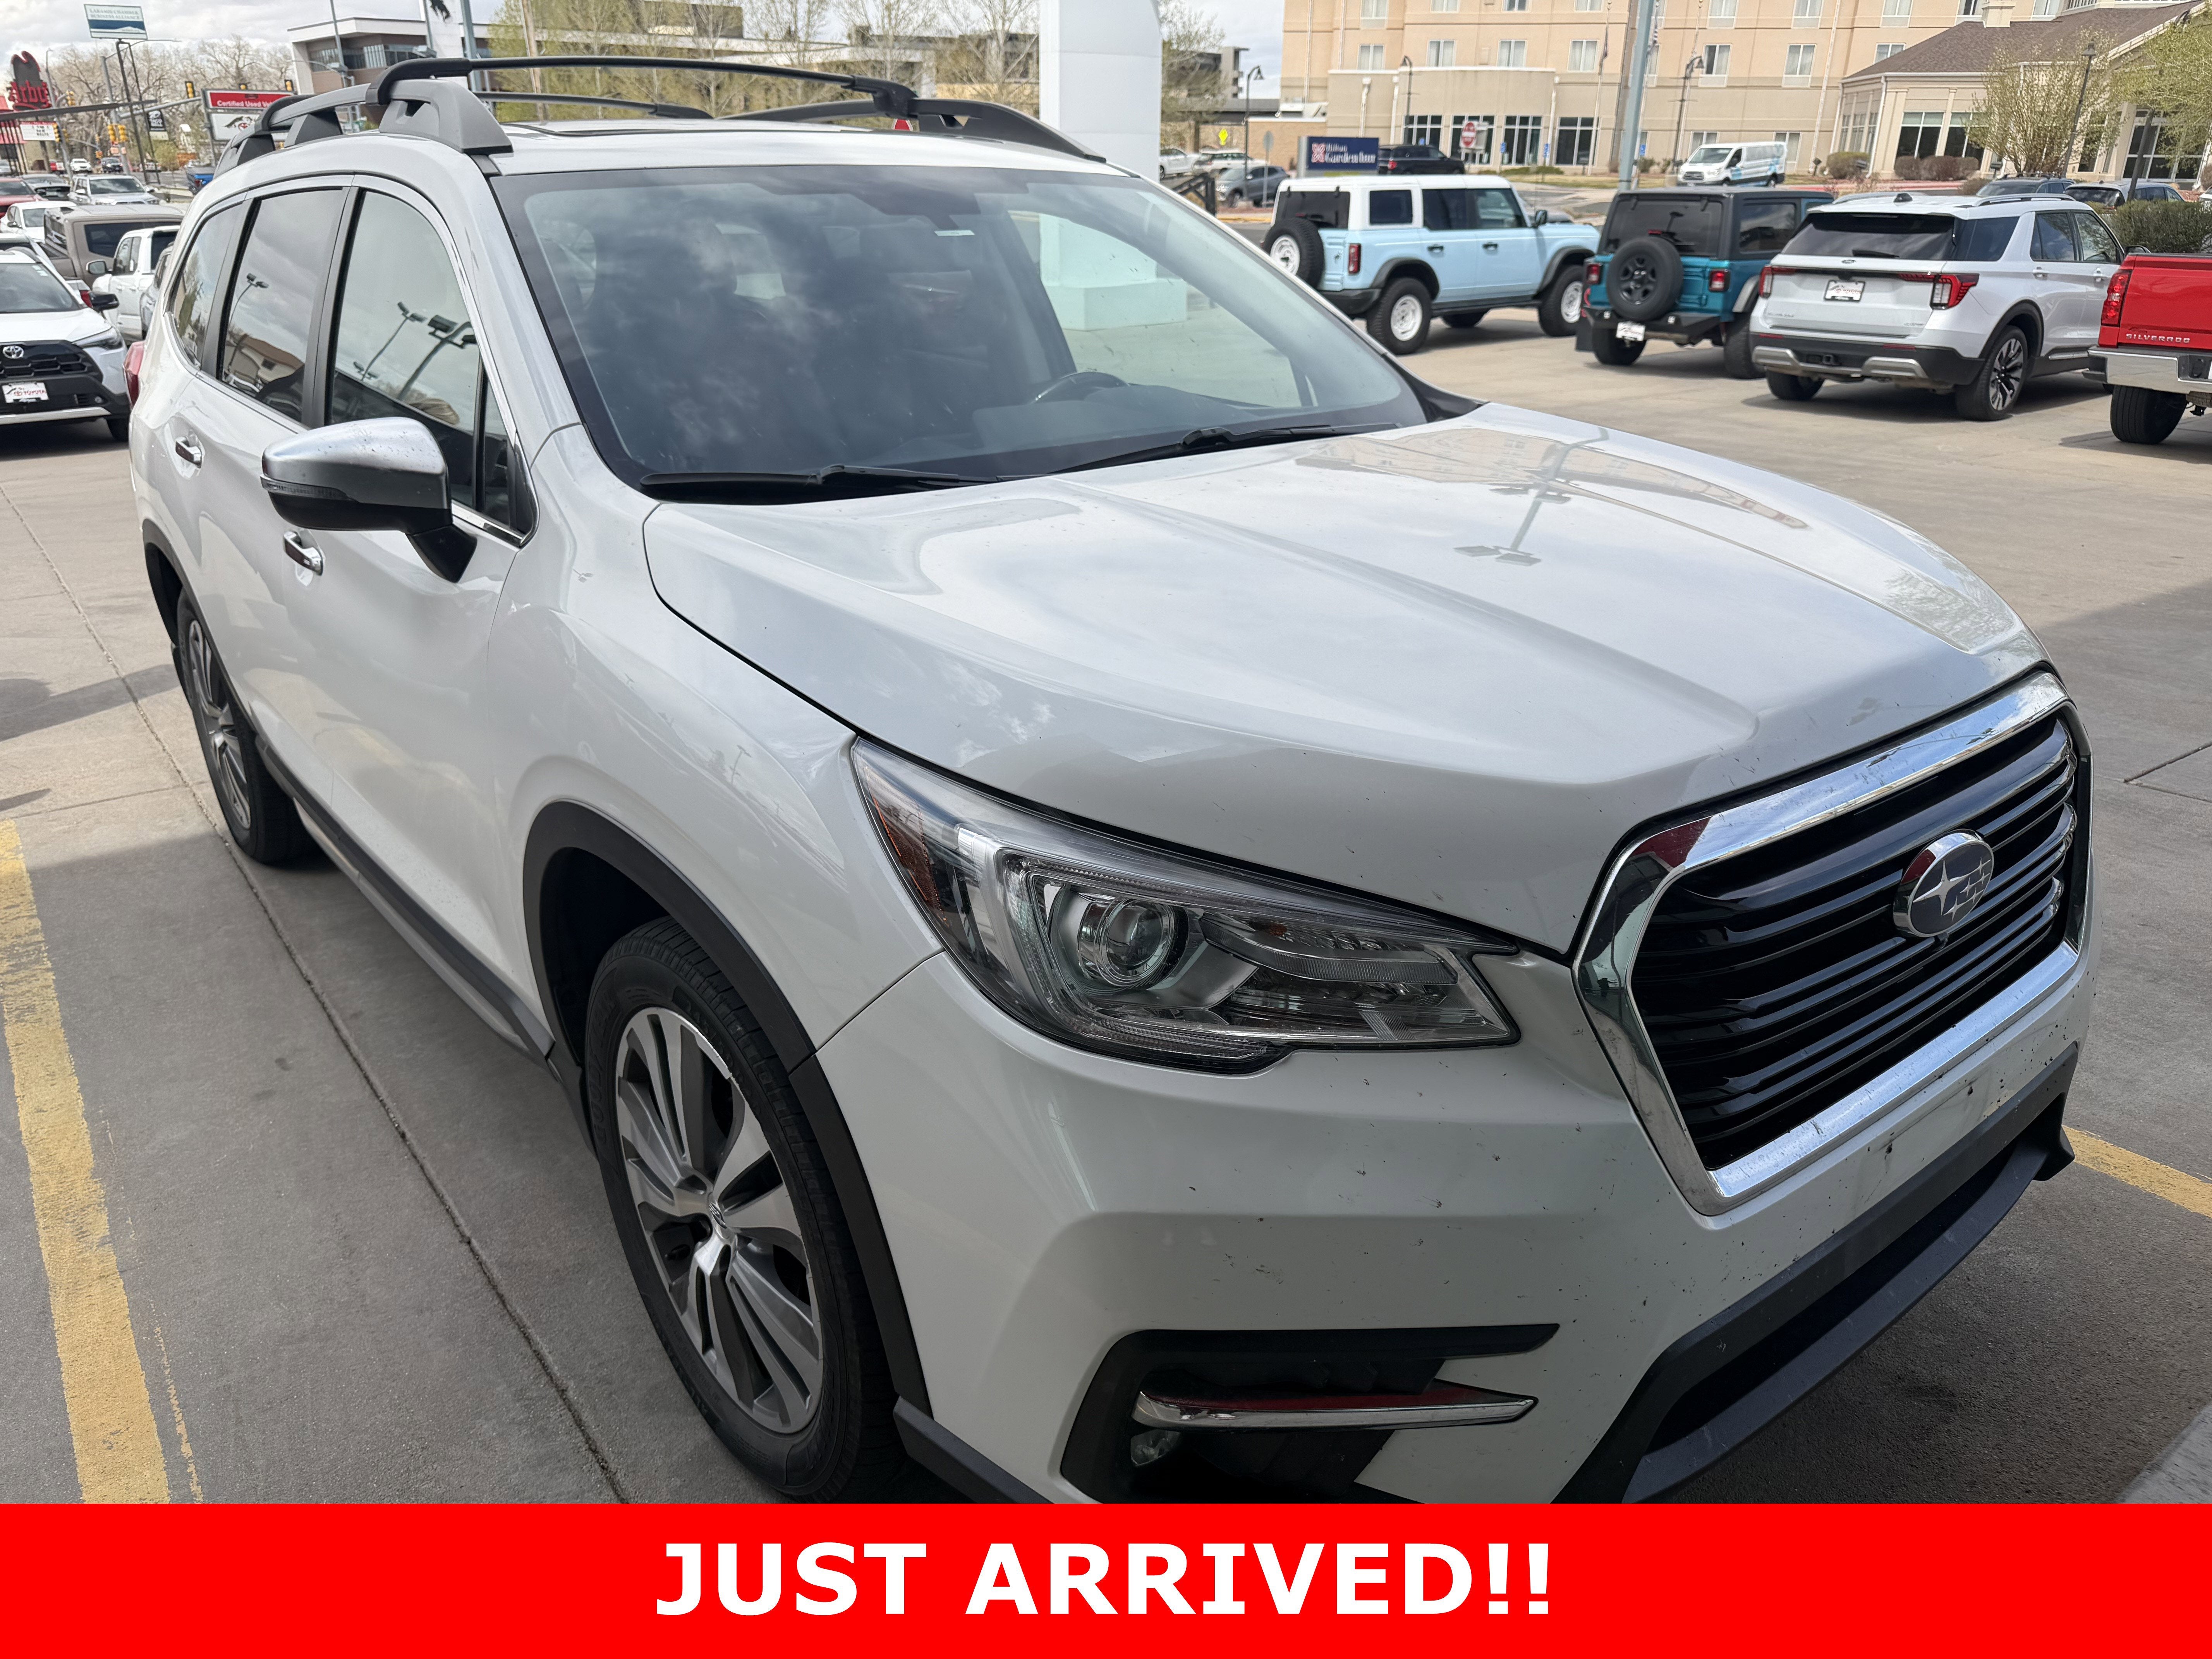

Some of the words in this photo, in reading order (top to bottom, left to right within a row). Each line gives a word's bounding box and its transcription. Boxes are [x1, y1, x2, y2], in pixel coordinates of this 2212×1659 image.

[1325, 151, 1358, 163] Garden
[1359, 150, 1376, 163] Inn
[2126, 333, 2190, 343] SILVERADO
